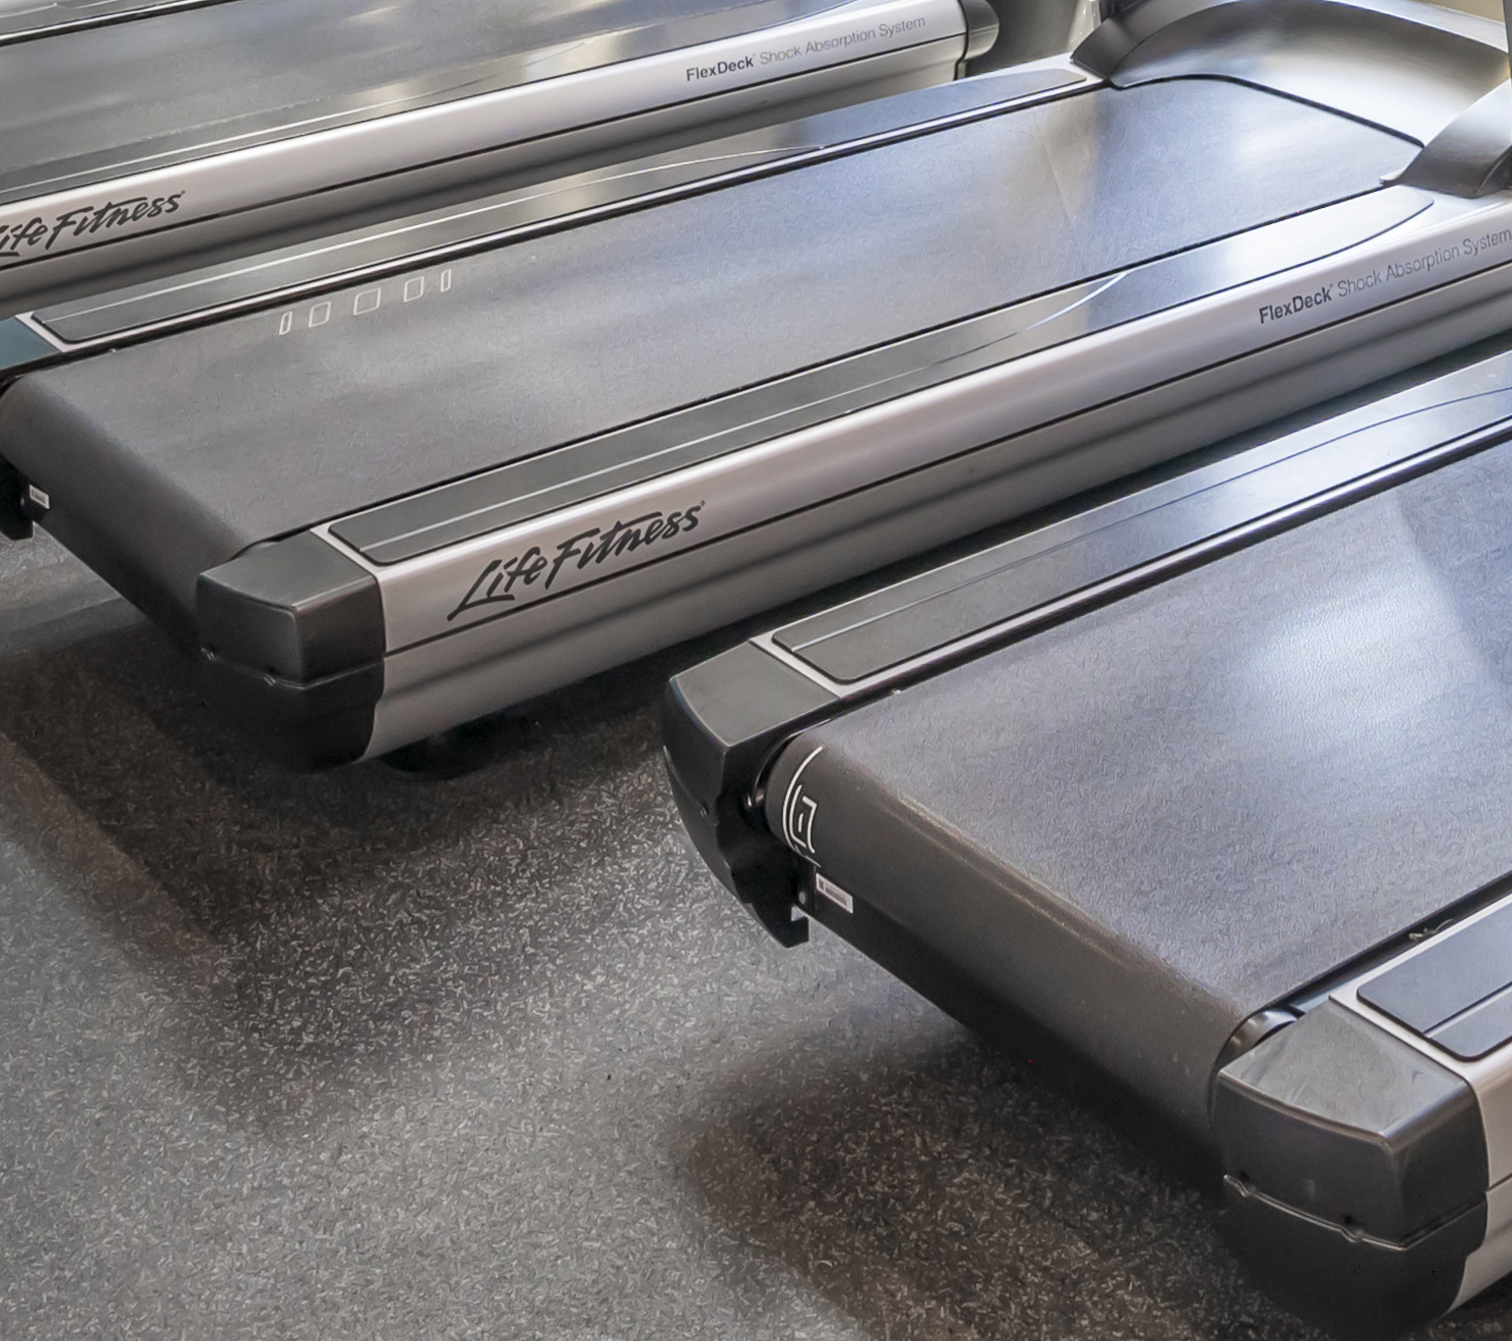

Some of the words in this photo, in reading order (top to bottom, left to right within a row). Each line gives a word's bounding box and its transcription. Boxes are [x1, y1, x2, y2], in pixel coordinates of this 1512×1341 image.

[686, 55, 756, 82] FlexDeck
[759, 45, 802, 66] Shock
[804, 27, 878, 55] Absorption
[879, 17, 926, 38] System
[44, 190, 186, 251] Fitness
[1258, 284, 1333, 324] FlexDeck
[1337, 269, 1383, 298] Shock
[1385, 248, 1461, 283] Absorption
[1461, 228, 1512, 263] System
[544, 501, 706, 591] Fitness
